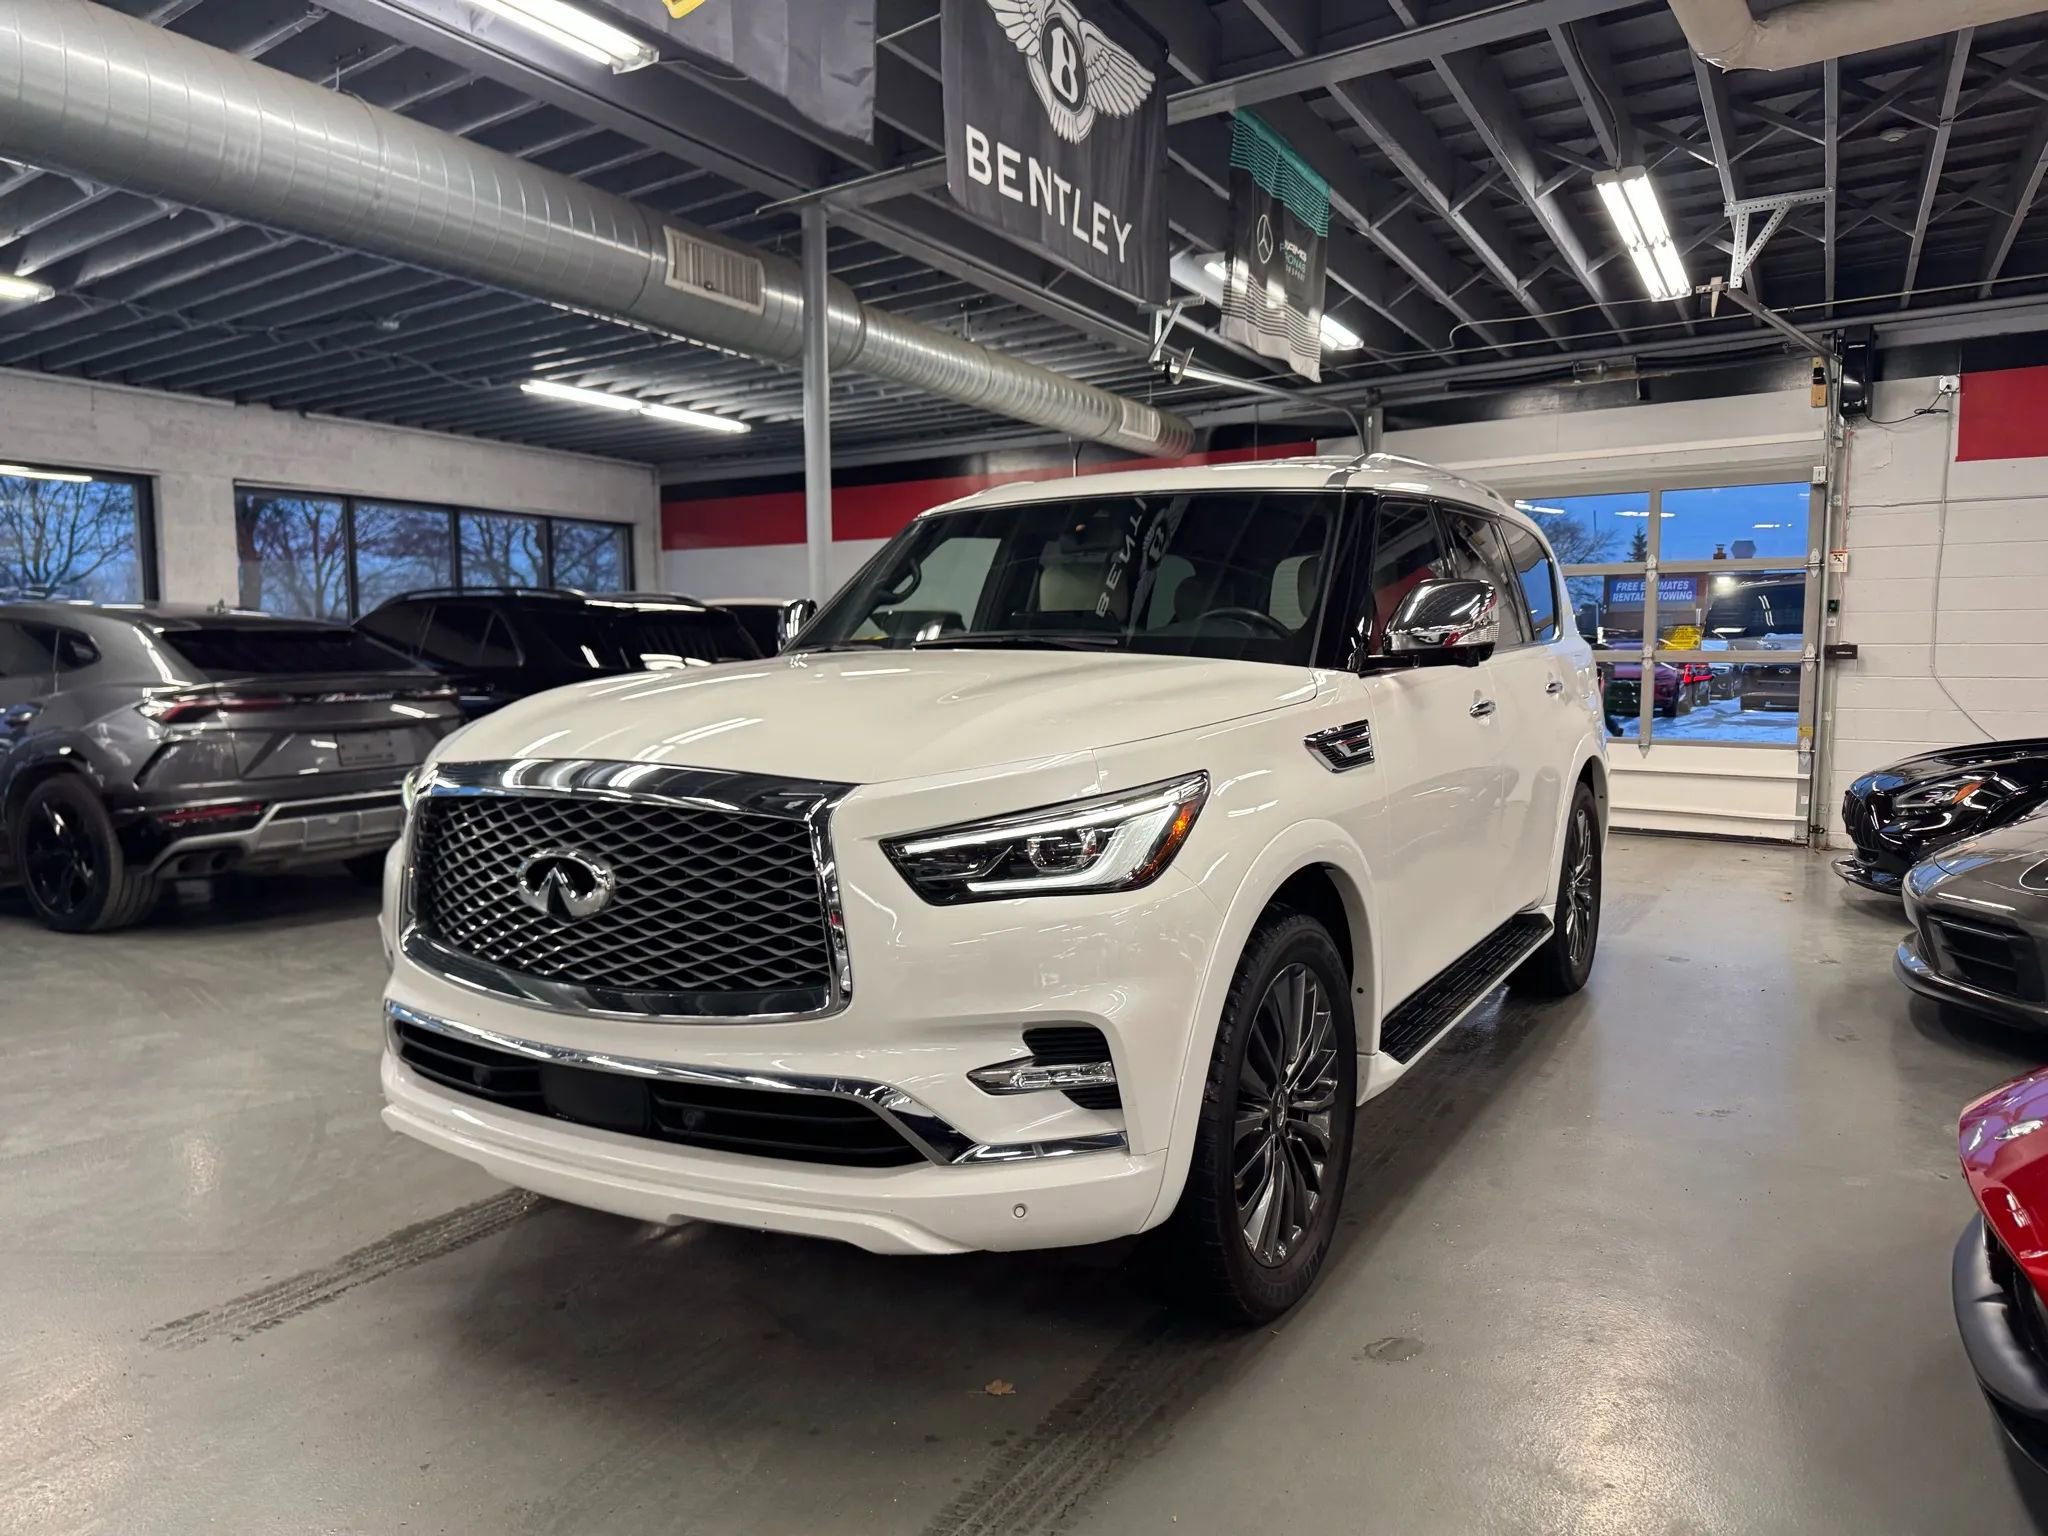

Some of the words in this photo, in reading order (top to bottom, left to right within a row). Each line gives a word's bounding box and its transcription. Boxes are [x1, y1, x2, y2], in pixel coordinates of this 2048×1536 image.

[1050, 27, 1078, 103] B
[966, 124, 1132, 263] BENTLEY
[1616, 582, 1639, 591] FREE
[1657, 591, 1693, 601] TOWING
